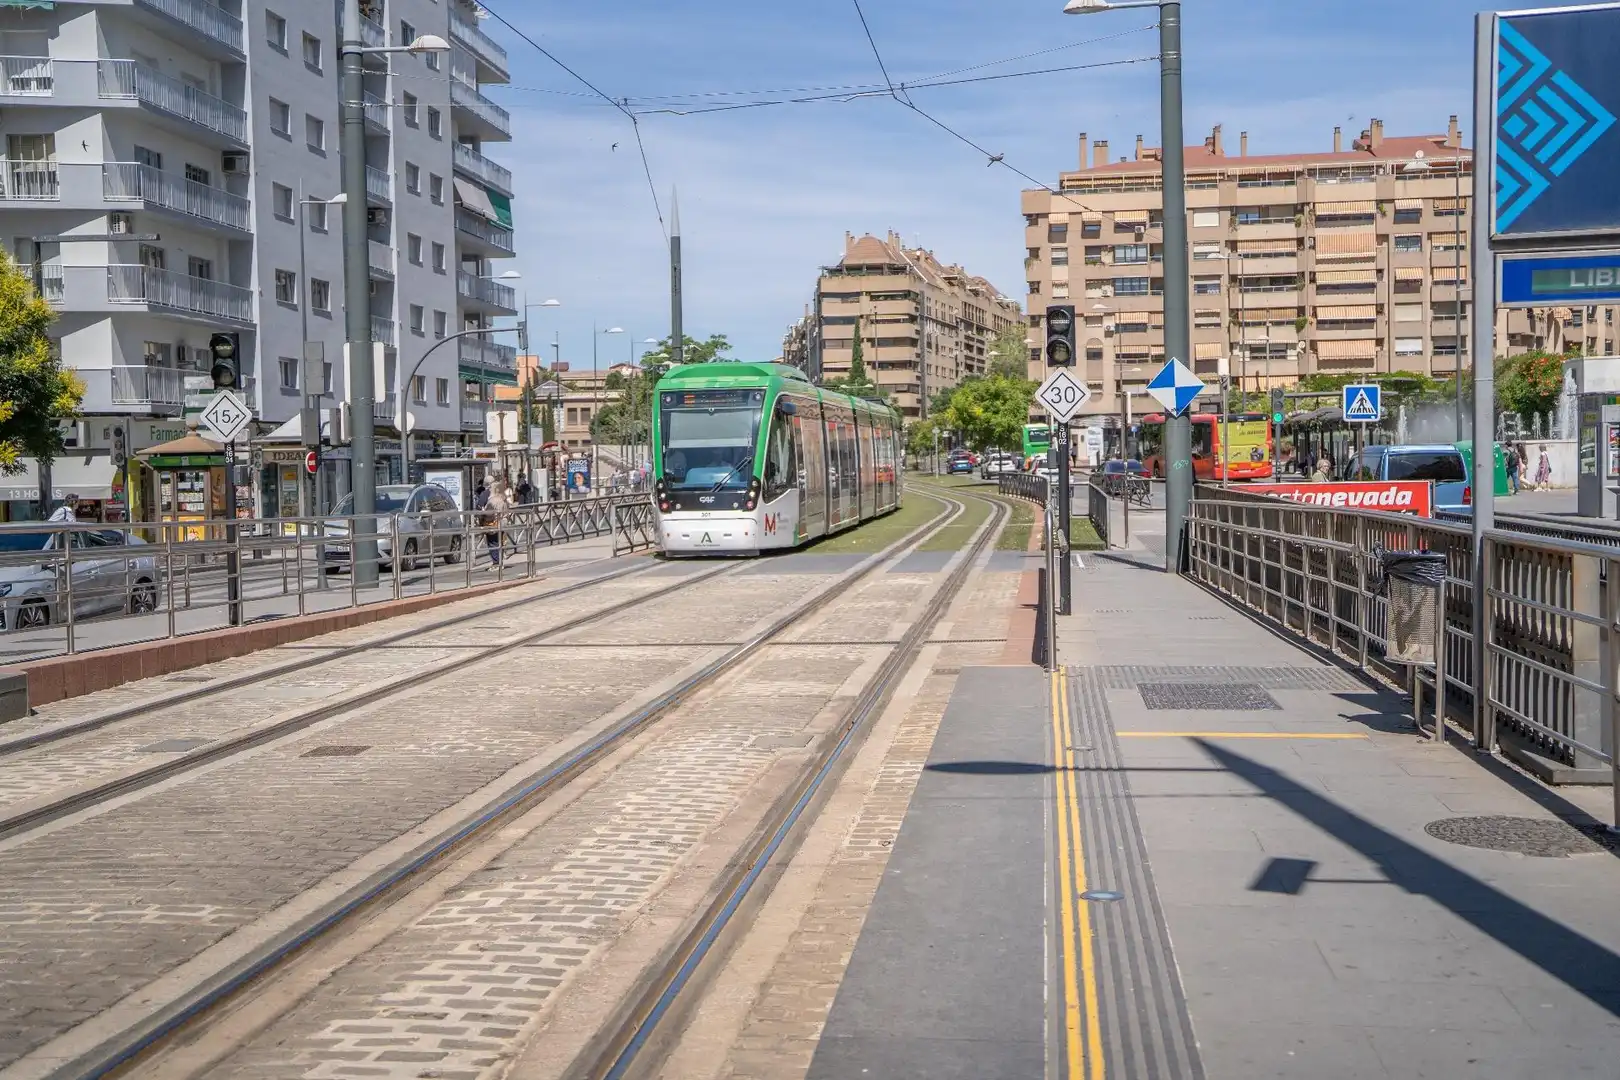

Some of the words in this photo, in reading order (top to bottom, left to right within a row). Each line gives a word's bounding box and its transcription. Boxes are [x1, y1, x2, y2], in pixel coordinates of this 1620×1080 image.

[1570, 268, 1620, 287] LIB
[1051, 386, 1075, 404] 30
[212, 409, 231, 424] 15
[8, 489, 20, 499] 13
[24, 489, 62, 499] HOS
